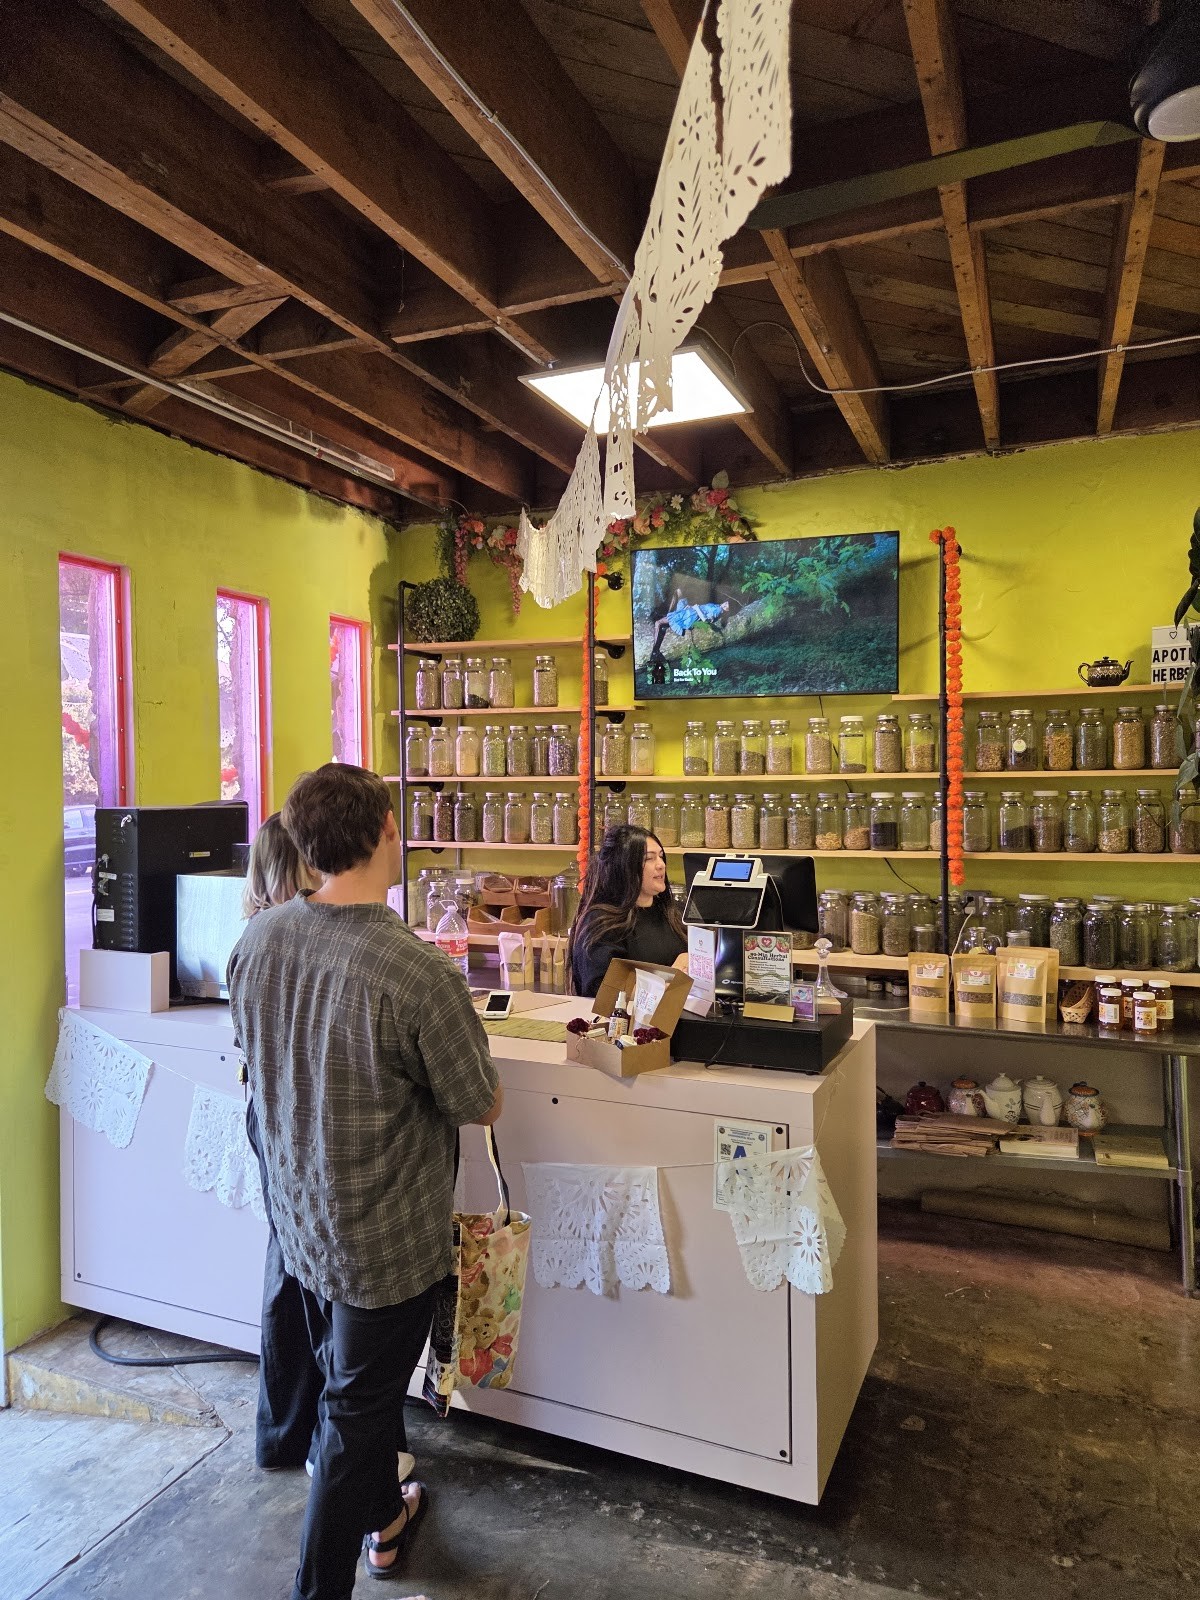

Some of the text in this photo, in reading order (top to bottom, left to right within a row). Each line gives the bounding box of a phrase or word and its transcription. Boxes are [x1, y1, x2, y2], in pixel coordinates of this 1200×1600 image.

[673, 668, 717, 676] Back To You
